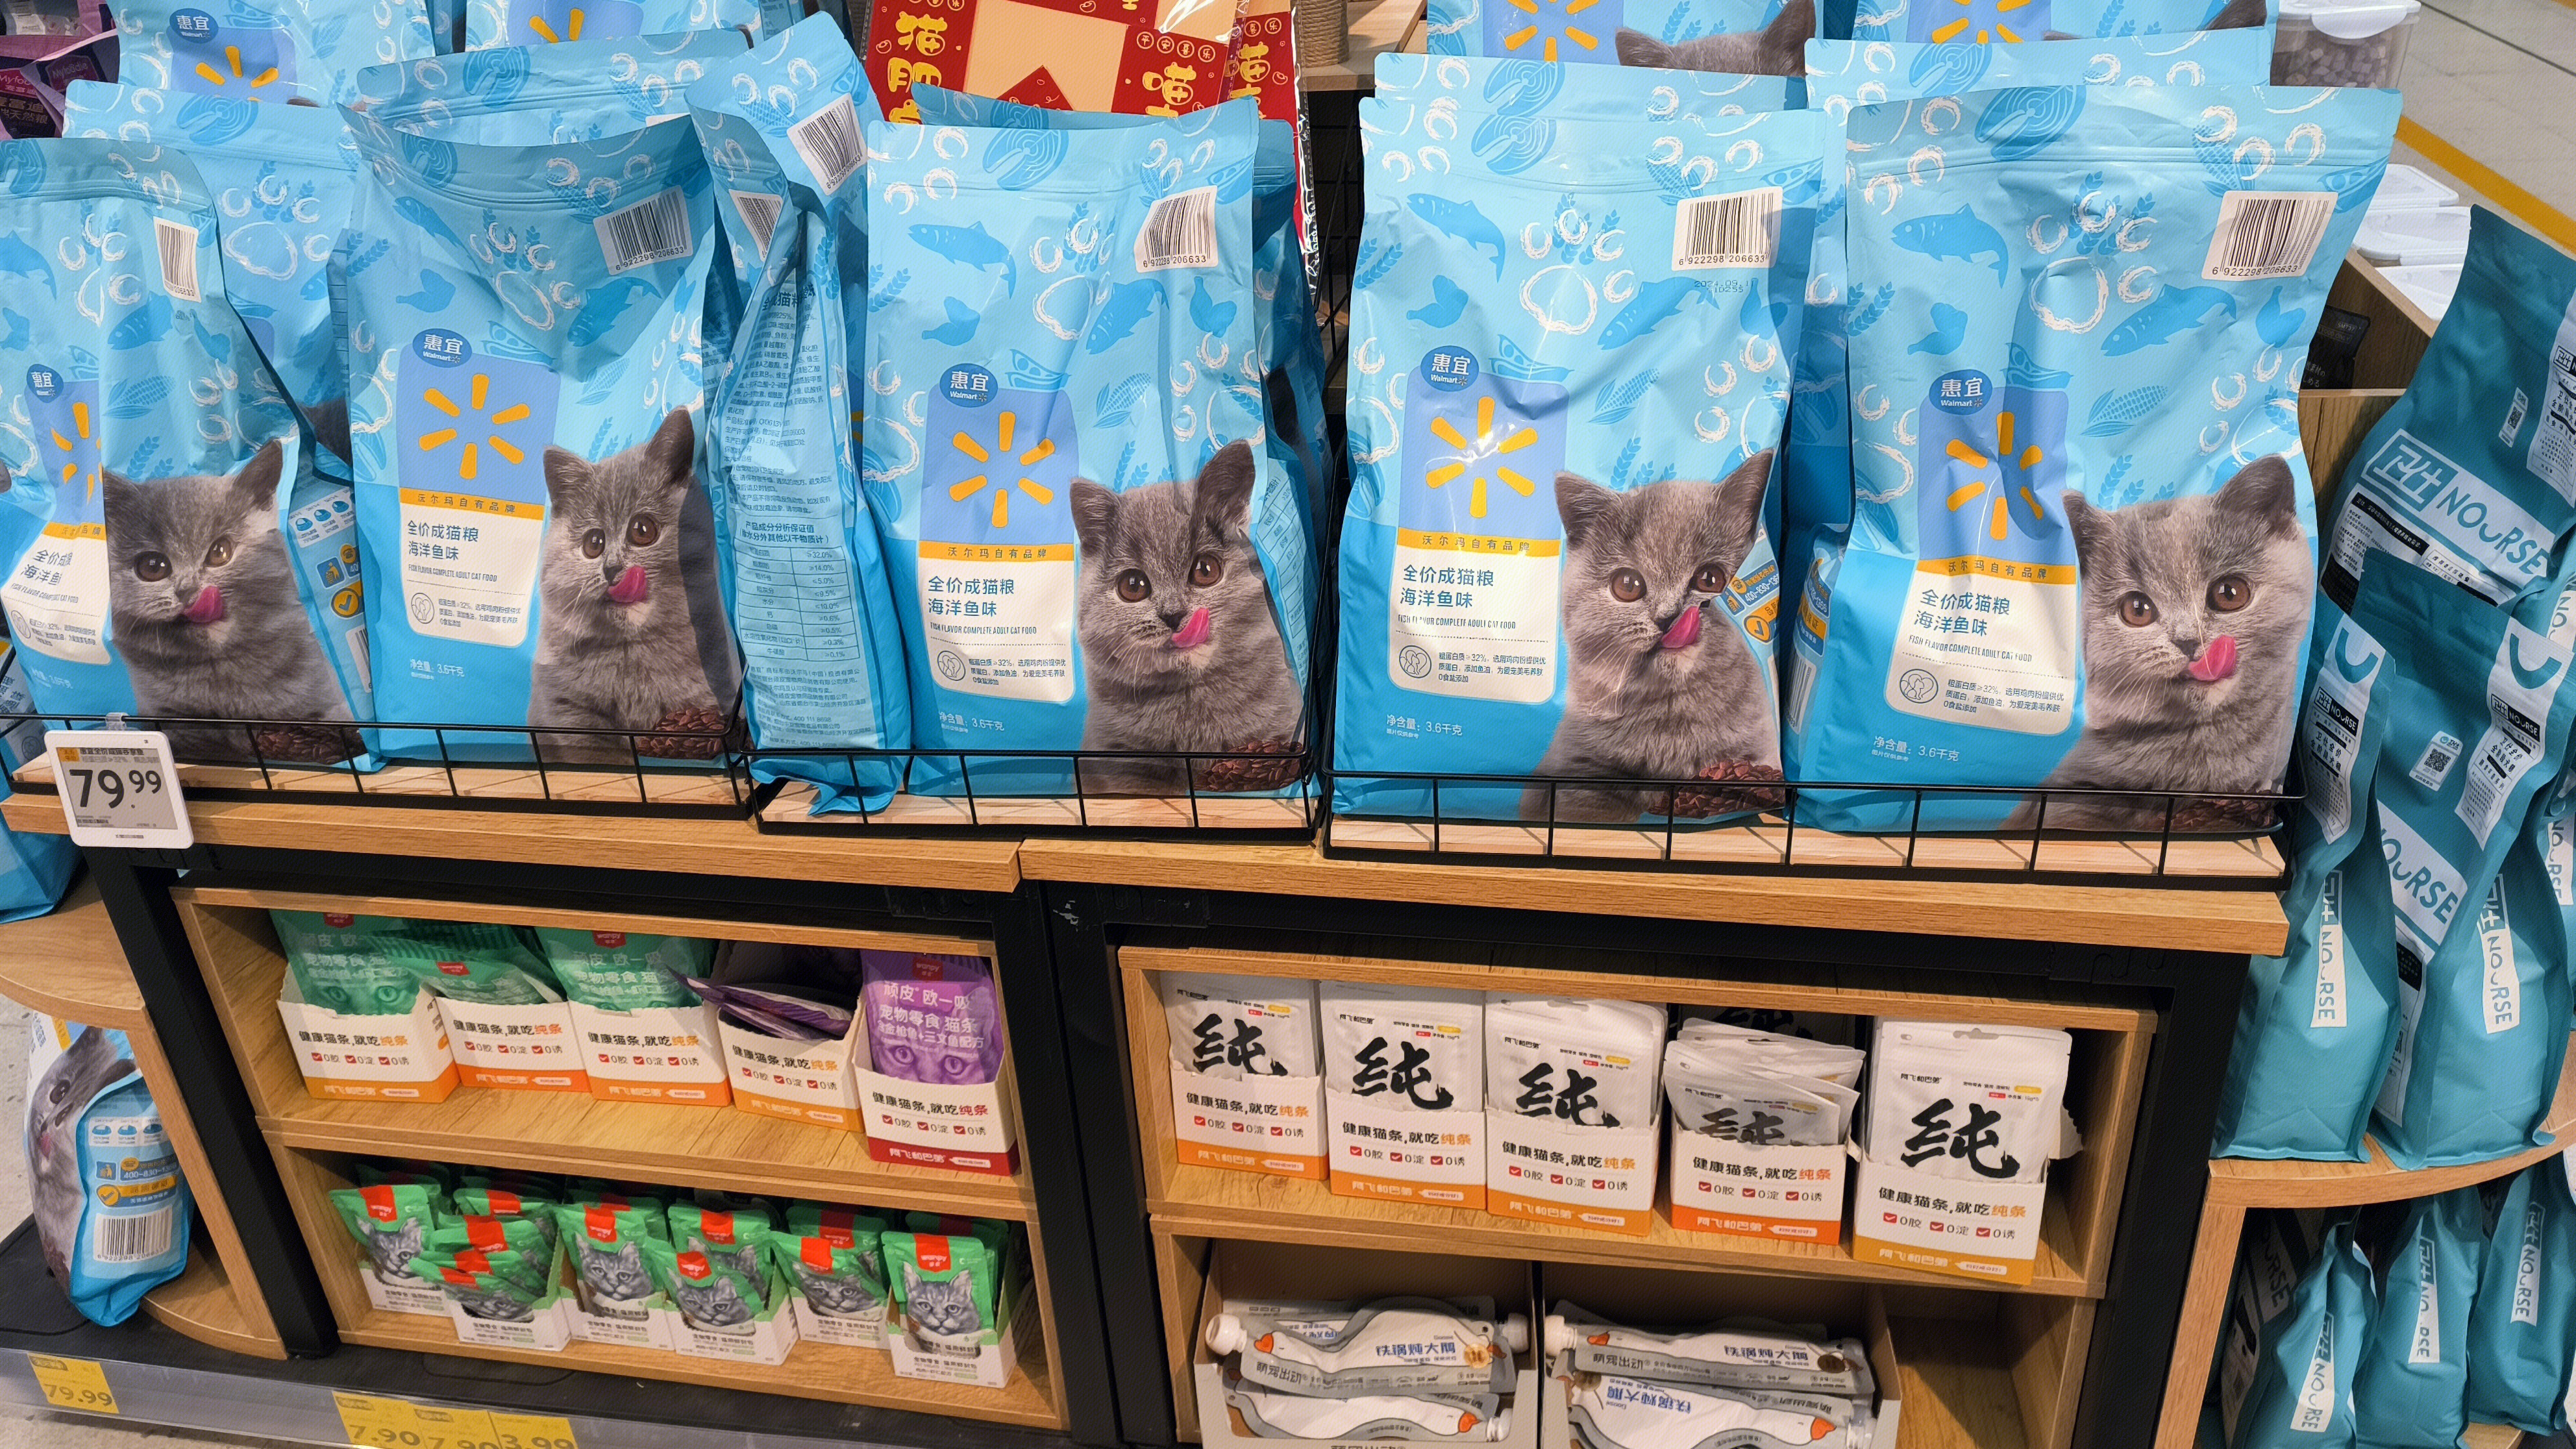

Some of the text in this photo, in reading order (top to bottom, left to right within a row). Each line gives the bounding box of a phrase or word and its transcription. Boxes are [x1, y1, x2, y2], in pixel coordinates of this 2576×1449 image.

[177, 14, 210, 31] 惠宜
[423, 334, 464, 356] 惠宜
[1431, 354, 1470, 376] 惠宜
[950, 371, 989, 392] 惠宜
[1431, 374, 1458, 385] Walmart
[1940, 378, 1983, 398] 惠宜
[950, 391, 977, 401] Walmart
[1940, 399, 1972, 408] Walmart
[417, 493, 516, 514] 沃尔玛自有品牌
[408, 520, 478, 543] 全价成猫粮
[2436, 487, 2549, 575] NOURSE
[408, 542, 459, 561] 海洋鱼味
[948, 547, 1047, 559] 沃尔玛自有品牌
[1422, 535, 1530, 552] 沃尔玛自有品牌
[1404, 565, 1494, 587] 全价成猫粮
[1949, 560, 2047, 580] 沃尔玛自有品牌
[928, 576, 1015, 596] 全价成猫粮
[928, 599, 997, 617] 海洋鱼味
[1400, 588, 1473, 609] 海洋鱼味
[1920, 589, 2011, 616] 全价成猫粮
[941, 625, 962, 634] FLAVOR
[1436, 617, 1467, 627] COMPLETE
[1468, 619, 1486, 628] ADULT
[1500, 621, 1516, 629] FOOD
[1913, 609, 1988, 637] 海洋鱼味
[1909, 634, 2032, 662] FISH FLAVOR COMPLETE ADULT CAT FOOD
[2331, 705, 2357, 730] NOURSE
[2510, 710, 2538, 736] NOURSE
[2381, 829, 2458, 924] OURSE
[2318, 931, 2335, 1020] NOURSE
[2486, 937, 2512, 1024] NOURSE
[884, 982, 970, 1009] 顽皮 欧一吸
[880, 1004, 976, 1034] 宠物零食 猫条
[1193, 1013, 1287, 1077] 纯
[1352, 1037, 1454, 1109] 纯
[1515, 1063, 1620, 1128] 纯
[1901, 1098, 2020, 1178] 纯
[2516, 1248, 2536, 1317] NOURSE
[43, 1383, 112, 1407] 79.99
[2302, 1363, 2325, 1428] NOURSE
[349, 1424, 420, 1446] 7.90
[501, 1433, 573, 1449] 3.99
